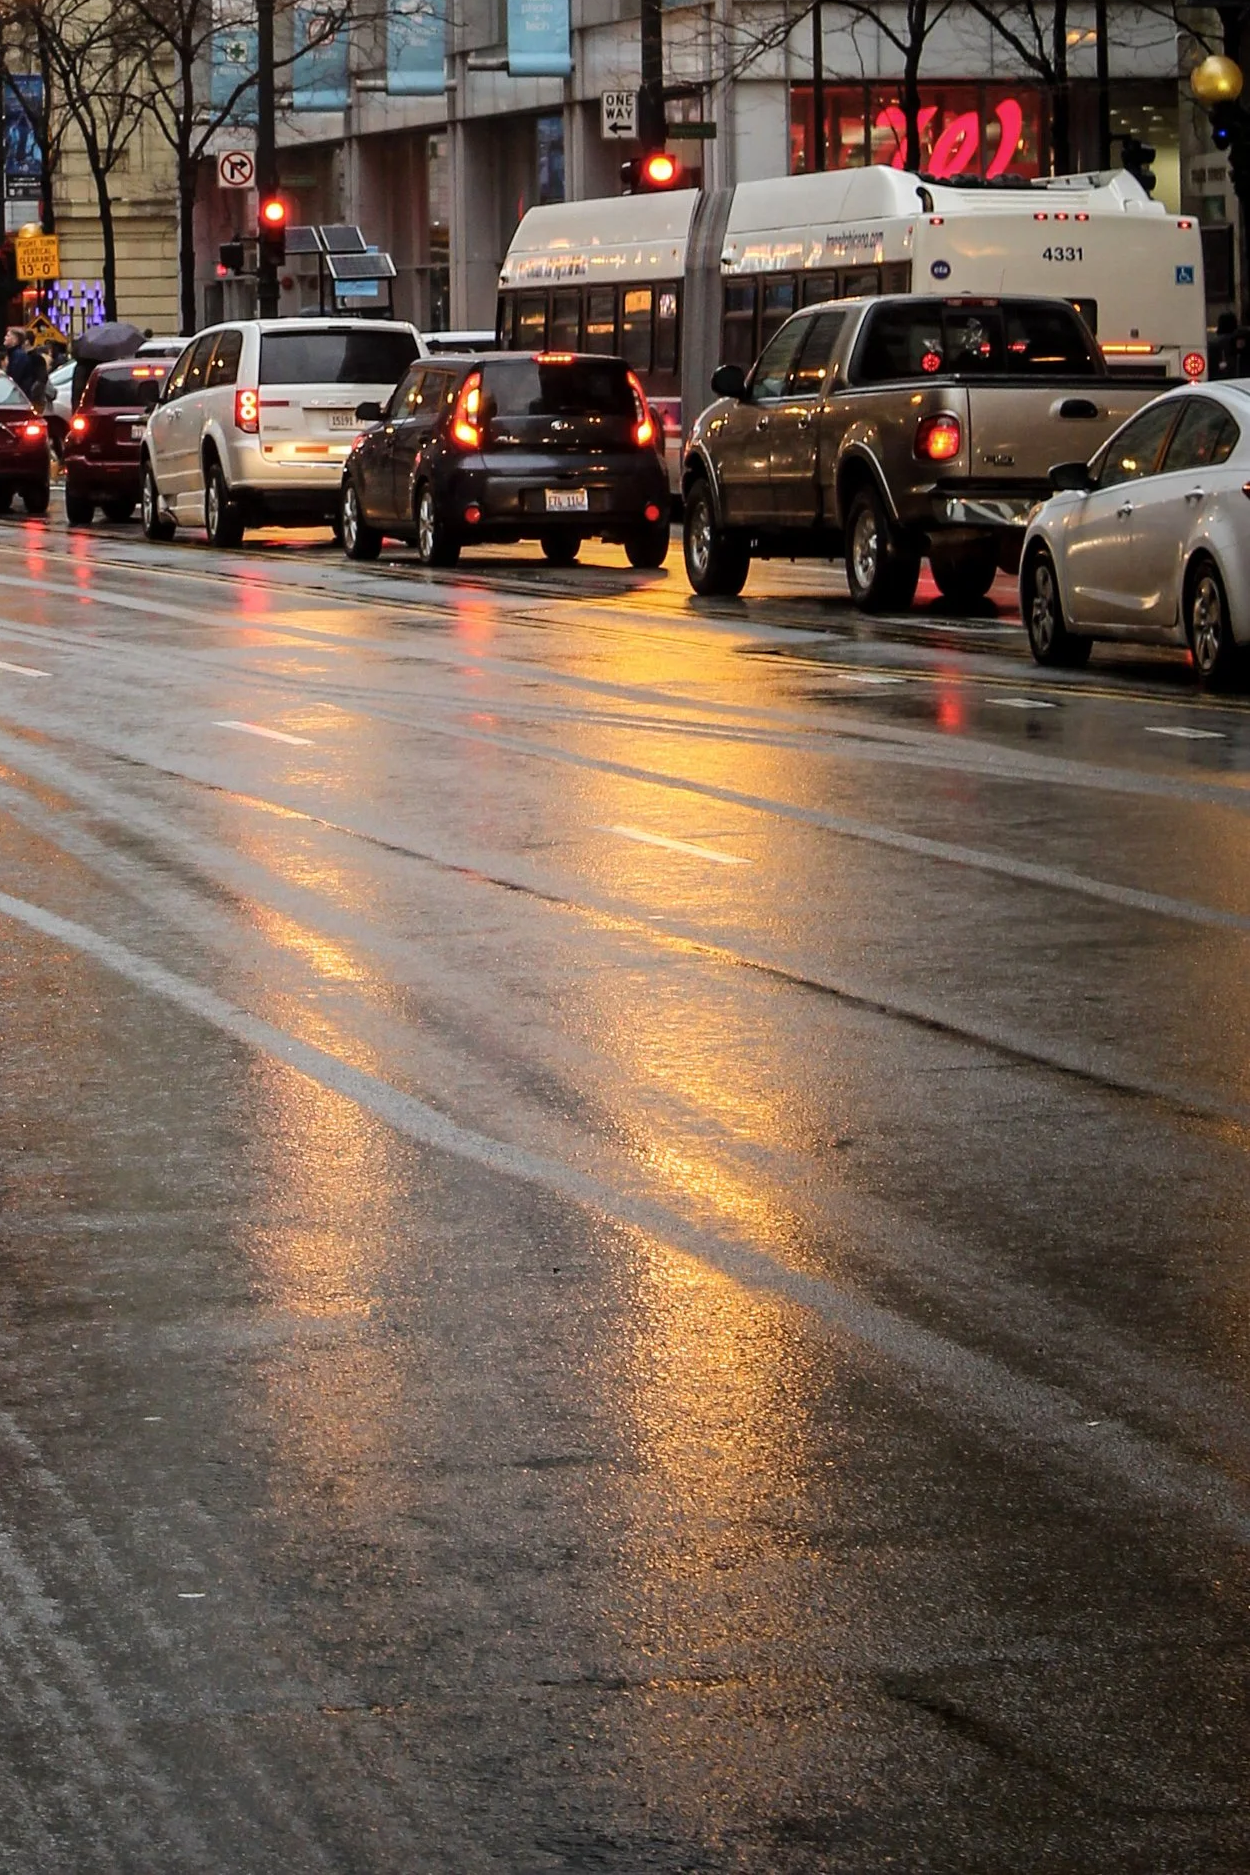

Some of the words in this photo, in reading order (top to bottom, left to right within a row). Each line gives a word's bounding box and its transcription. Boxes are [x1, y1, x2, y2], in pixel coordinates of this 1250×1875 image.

[605, 93, 634, 106] ONE
[605, 108, 633, 120] WAY
[1042, 246, 1084, 262] 4331
